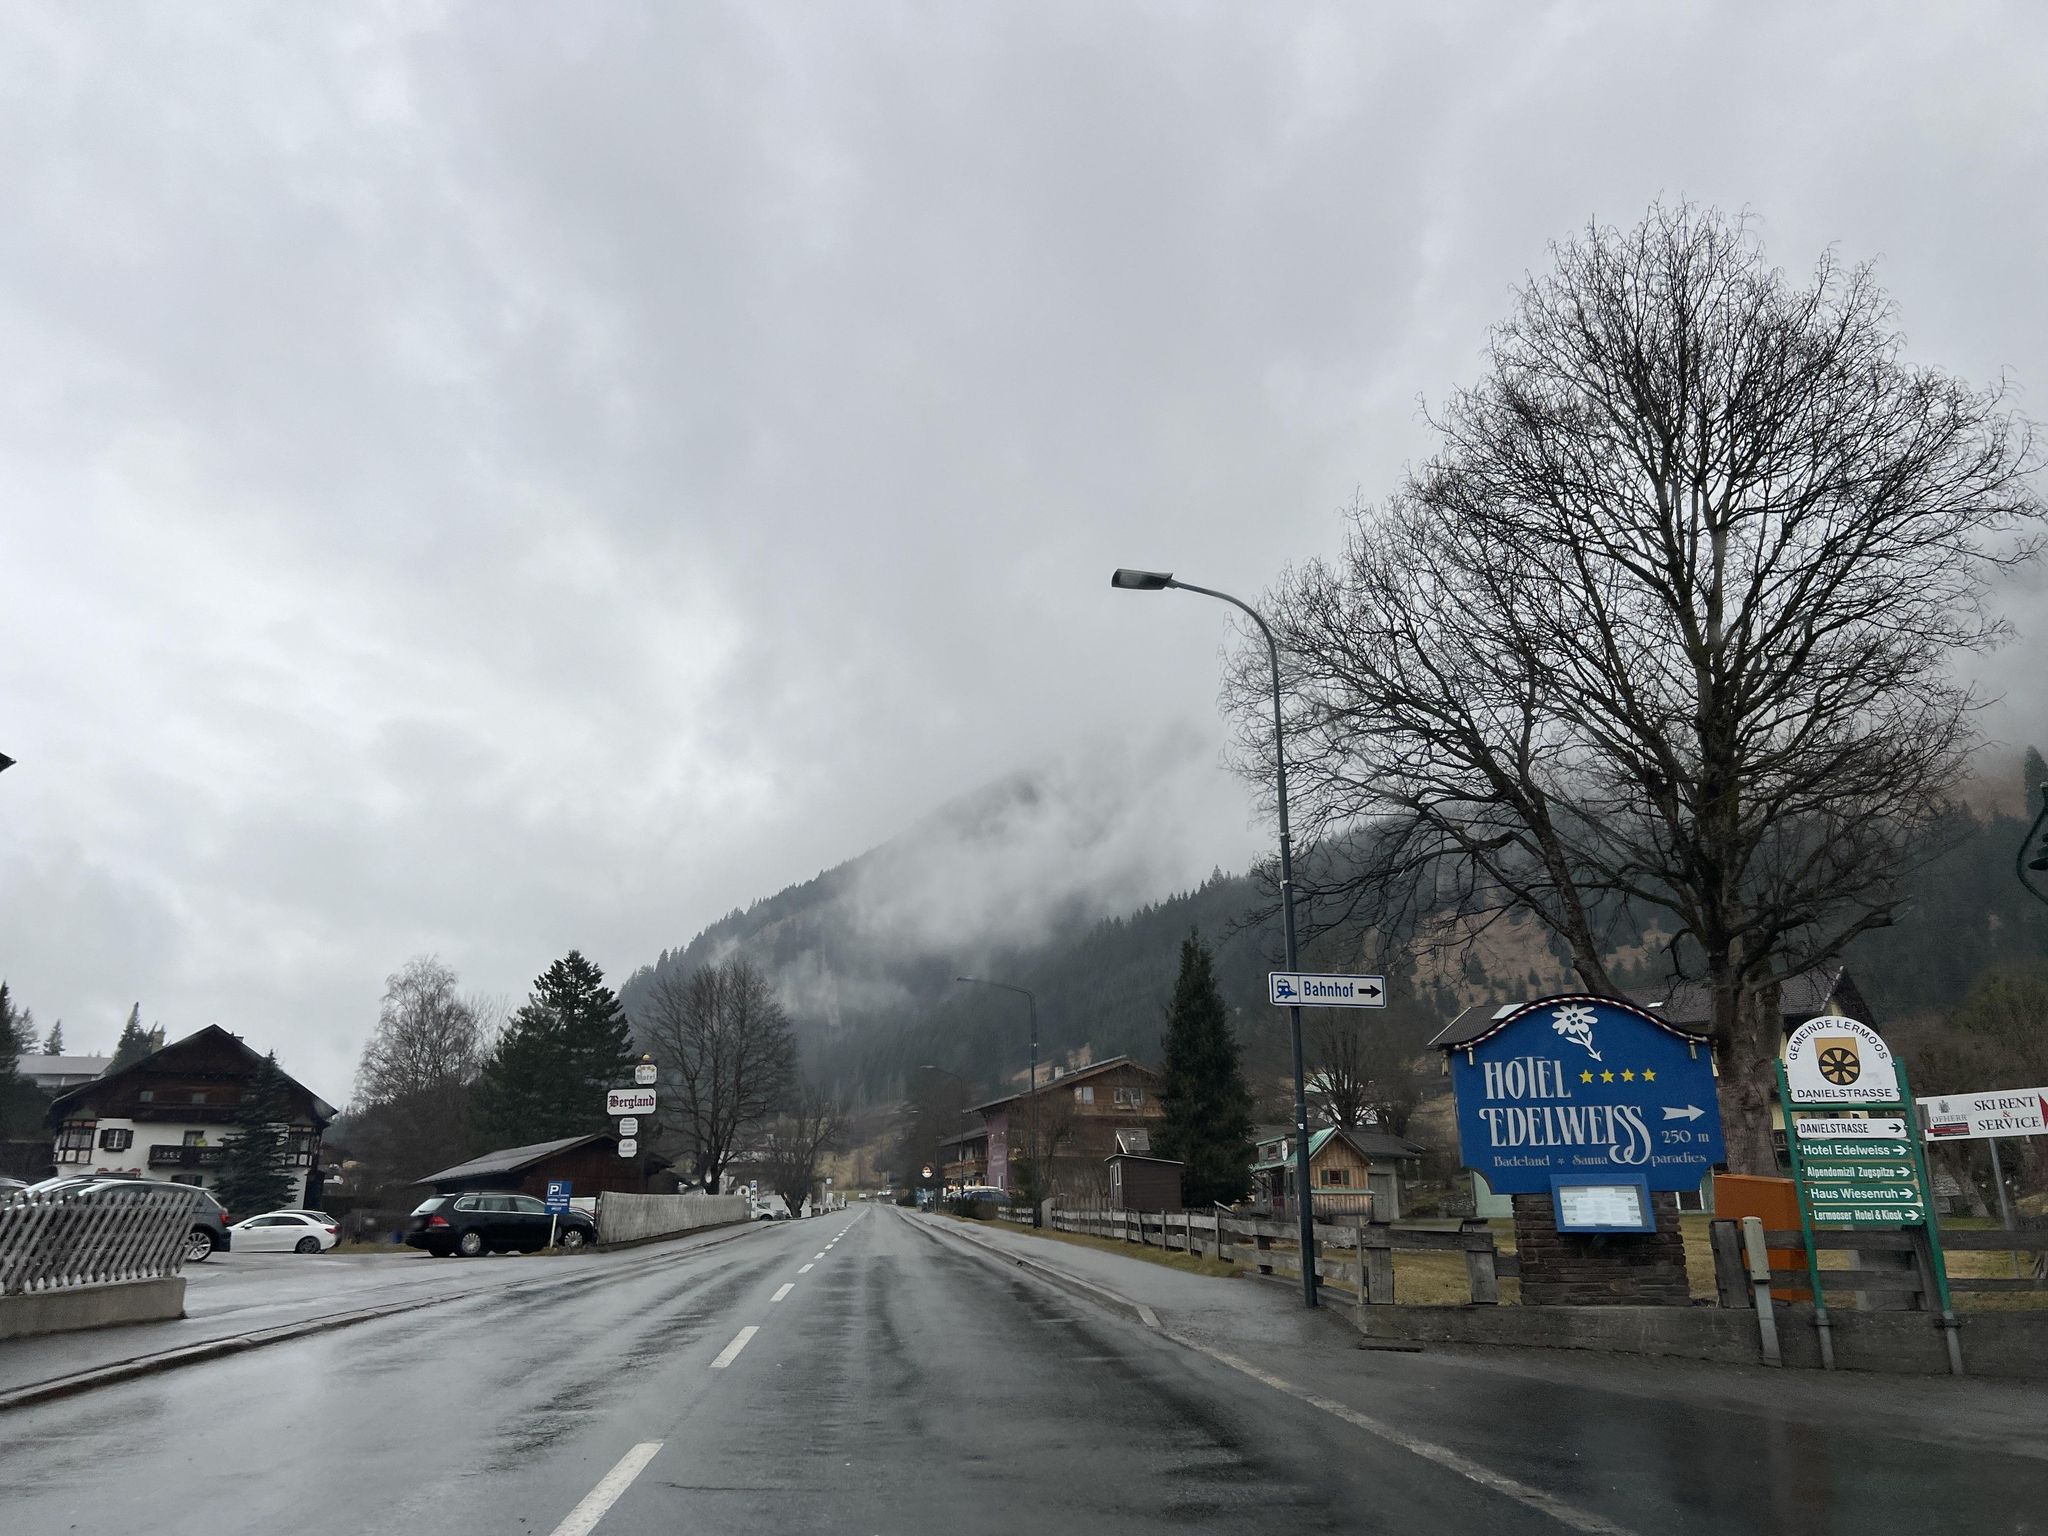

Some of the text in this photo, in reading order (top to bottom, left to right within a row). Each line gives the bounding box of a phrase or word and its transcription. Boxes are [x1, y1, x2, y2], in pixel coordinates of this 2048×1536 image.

[1304, 981, 1353, 997] Bahnhof
[1788, 1019, 1888, 1061] GEMEINDE LERMOOS
[1483, 1056, 1572, 1100] HOTEL
[1797, 1088, 1893, 1098] DANIELSTRASSE
[608, 1095, 655, 1109] Bergland
[1974, 1096, 2036, 1112] SKI RENT
[2002, 1110, 2011, 1118] &
[1800, 1123, 1869, 1134] DANIELSTRASSE
[1978, 1116, 2041, 1131] SERVICE
[1478, 1104, 1651, 1166] EDELWEISS
[1661, 1130, 1710, 1144] 250 m
[1803, 1144, 1890, 1155] Hotel Edelweiss
[1494, 1152, 1707, 1167] Badeland Sauna paradies
[1807, 1166, 1895, 1178] Alpendomizil Zugspitze
[550, 1185, 559, 1194] P
[1810, 1188, 1899, 1199] Haus Wiesenruh
[1814, 1210, 1904, 1221] Lermooser Hotel & Kiosk
